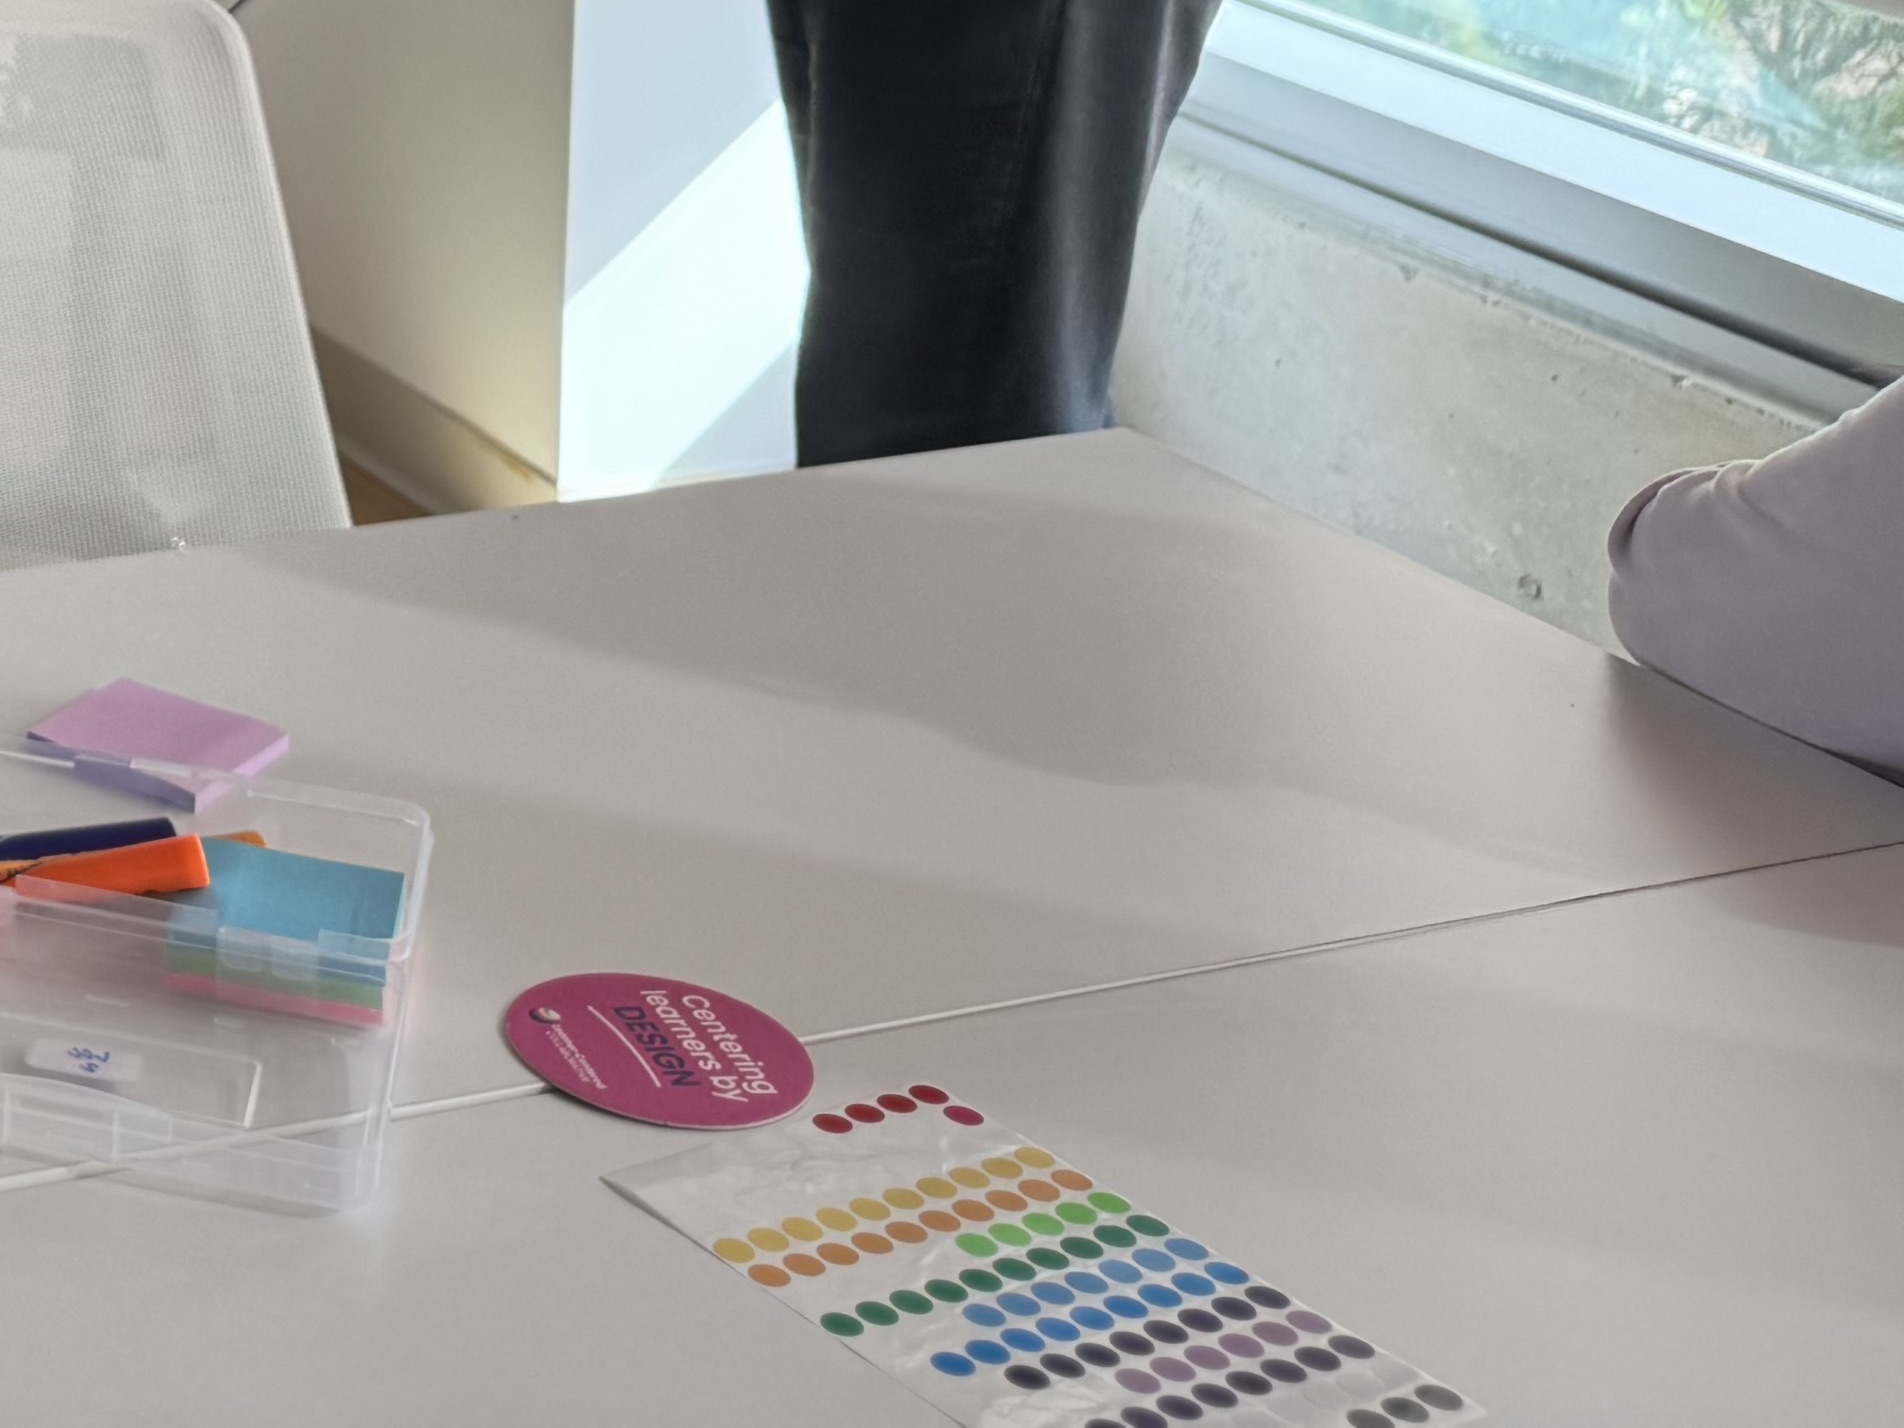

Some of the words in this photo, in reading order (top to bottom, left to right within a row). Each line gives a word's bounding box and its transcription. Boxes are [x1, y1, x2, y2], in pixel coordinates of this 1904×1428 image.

[613, 1005, 701, 1088] DESIGN
[640, 989, 721, 1071] learners
[709, 1075, 749, 1103] by
[681, 994, 779, 1095] Centering
